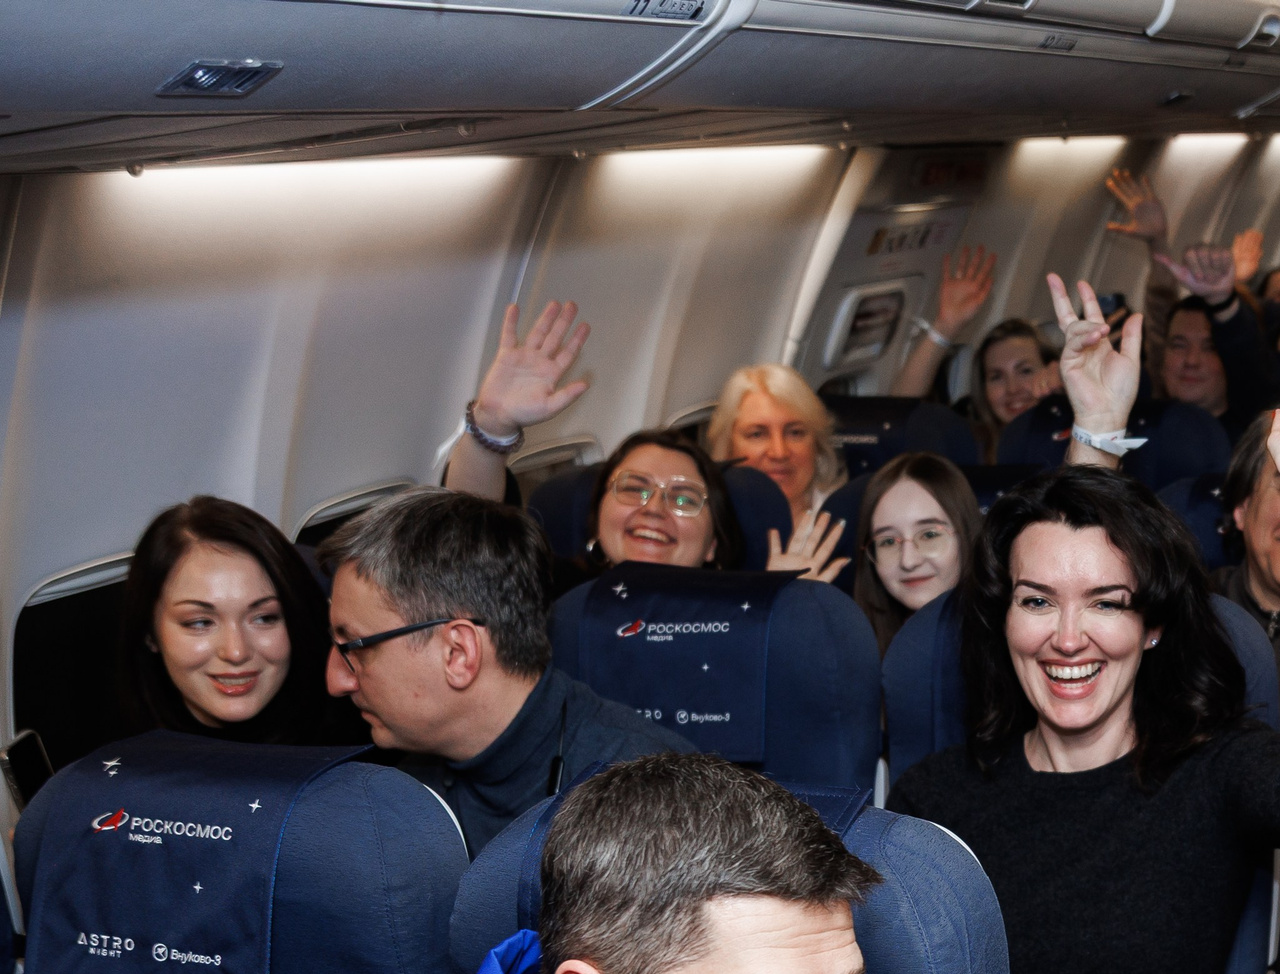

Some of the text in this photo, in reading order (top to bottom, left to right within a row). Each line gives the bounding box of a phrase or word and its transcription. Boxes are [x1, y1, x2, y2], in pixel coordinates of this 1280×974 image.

[647, 622, 730, 634] РОСКОСМОС
[690, 713, 730, 723] Внуково-3
[130, 816, 233, 841] РОСКОСМОС
[128, 832, 163, 845] медиа
[77, 932, 135, 951] ASTRO
[88, 947, 122, 959] NIGHT
[169, 949, 222, 966] Внуково-3
